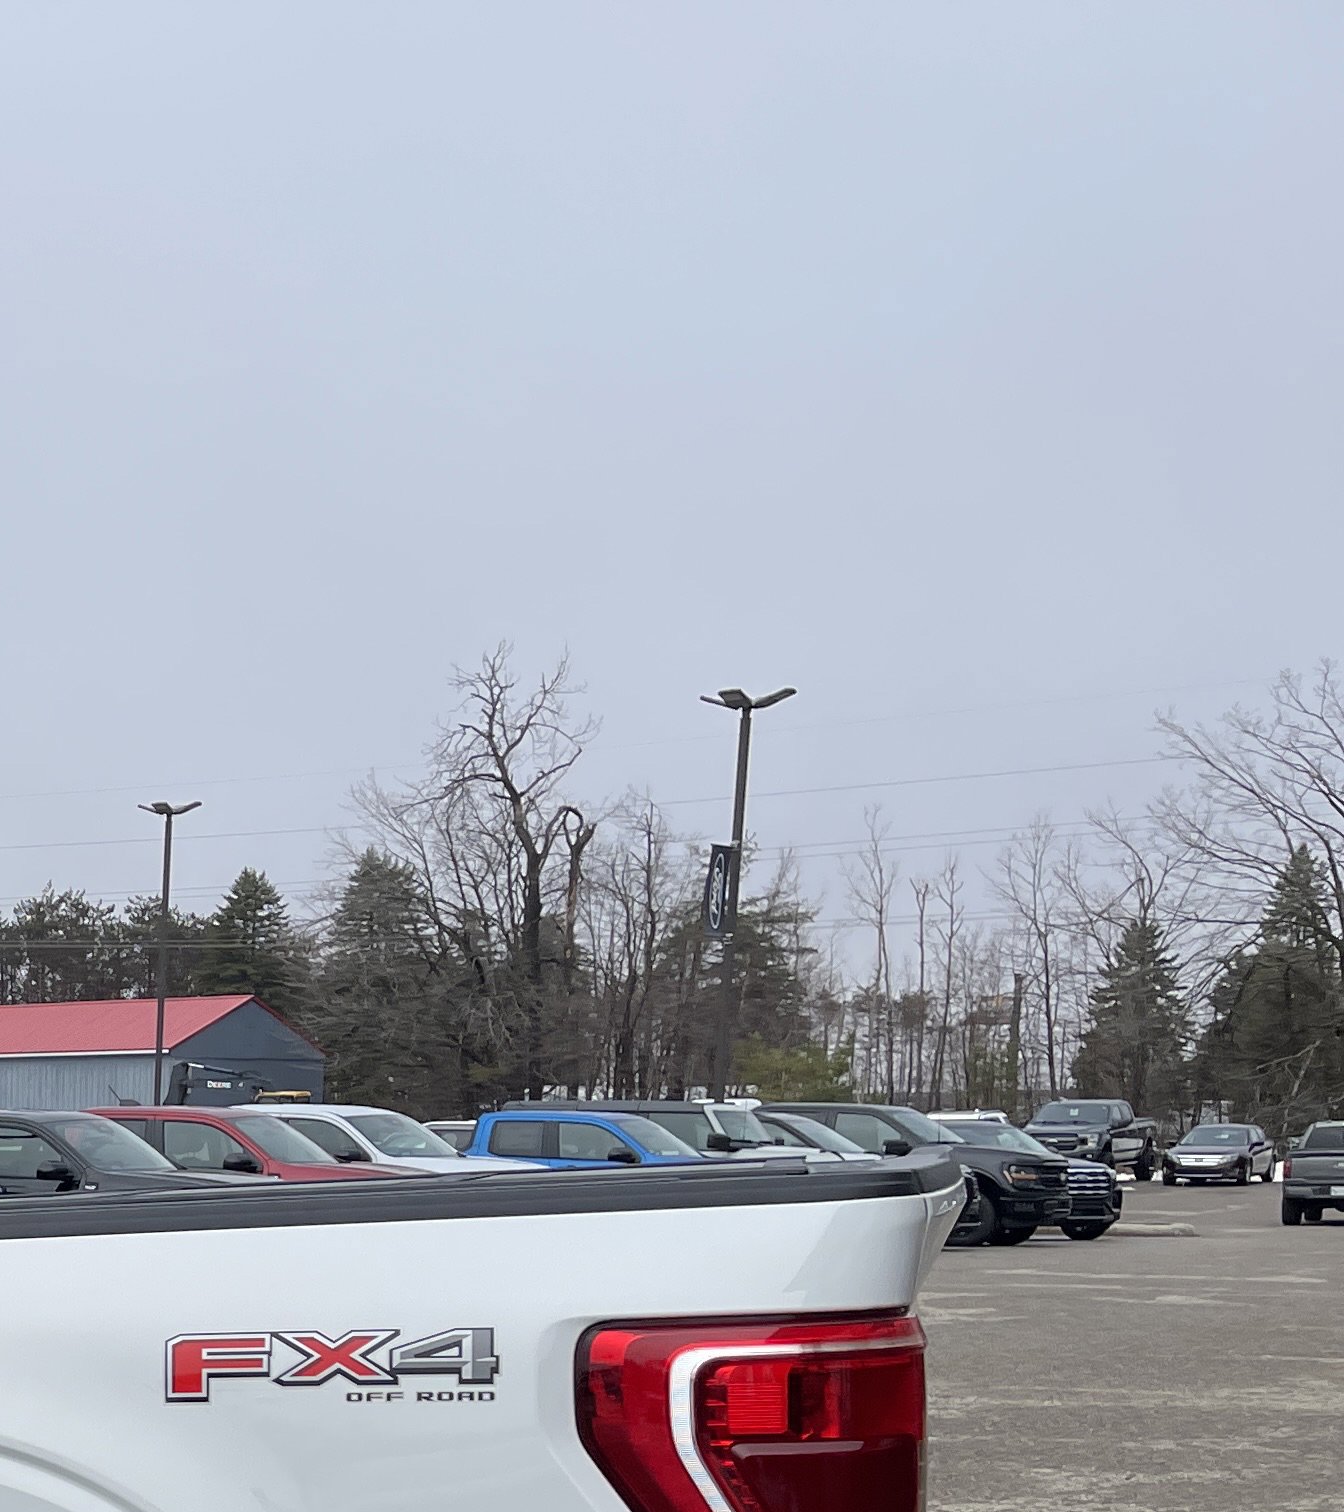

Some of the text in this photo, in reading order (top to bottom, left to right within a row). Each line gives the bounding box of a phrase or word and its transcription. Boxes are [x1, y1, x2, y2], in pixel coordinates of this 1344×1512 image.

[165, 1327, 500, 1403] FX4
[346, 1391, 495, 1403] OFF ROAD
